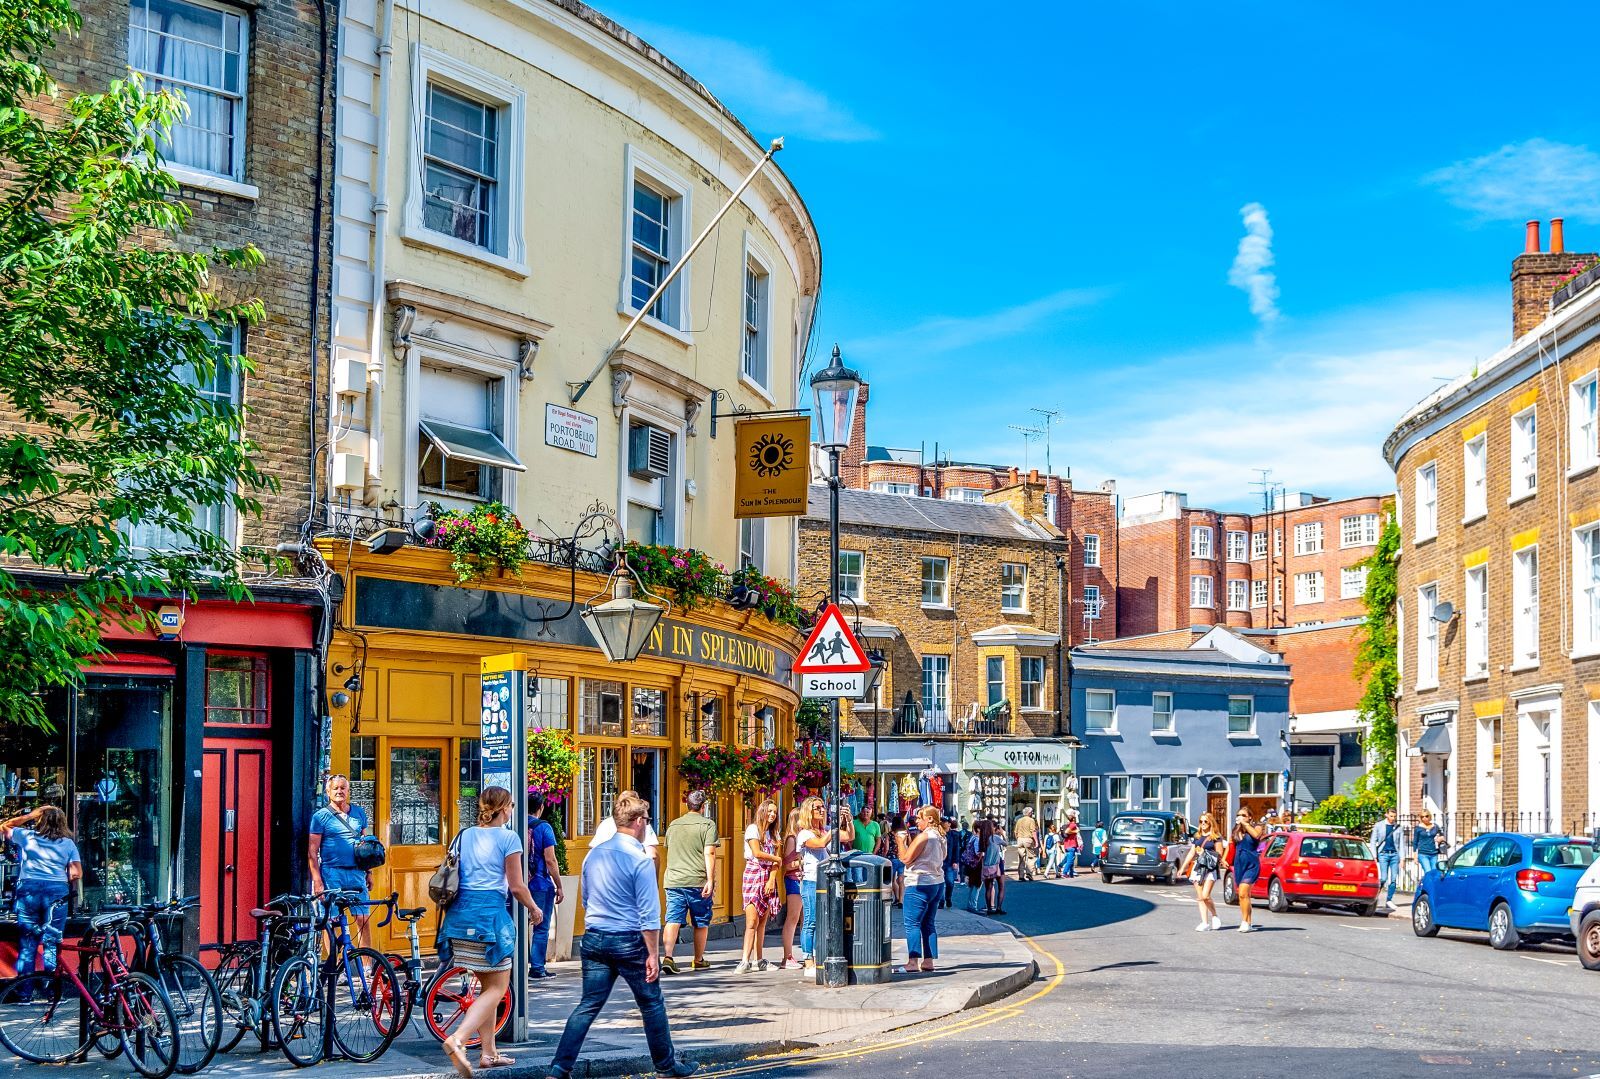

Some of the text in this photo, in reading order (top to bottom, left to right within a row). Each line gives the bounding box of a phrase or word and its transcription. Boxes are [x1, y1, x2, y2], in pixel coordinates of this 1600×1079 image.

[550, 422, 594, 443] PORTOBELLO
[162, 615, 178, 624] ADT
[671, 625, 694, 657] IN
[700, 631, 776, 676] SPLENDOUR
[810, 679, 856, 690] School
[1004, 751, 1041, 763] COTTON
